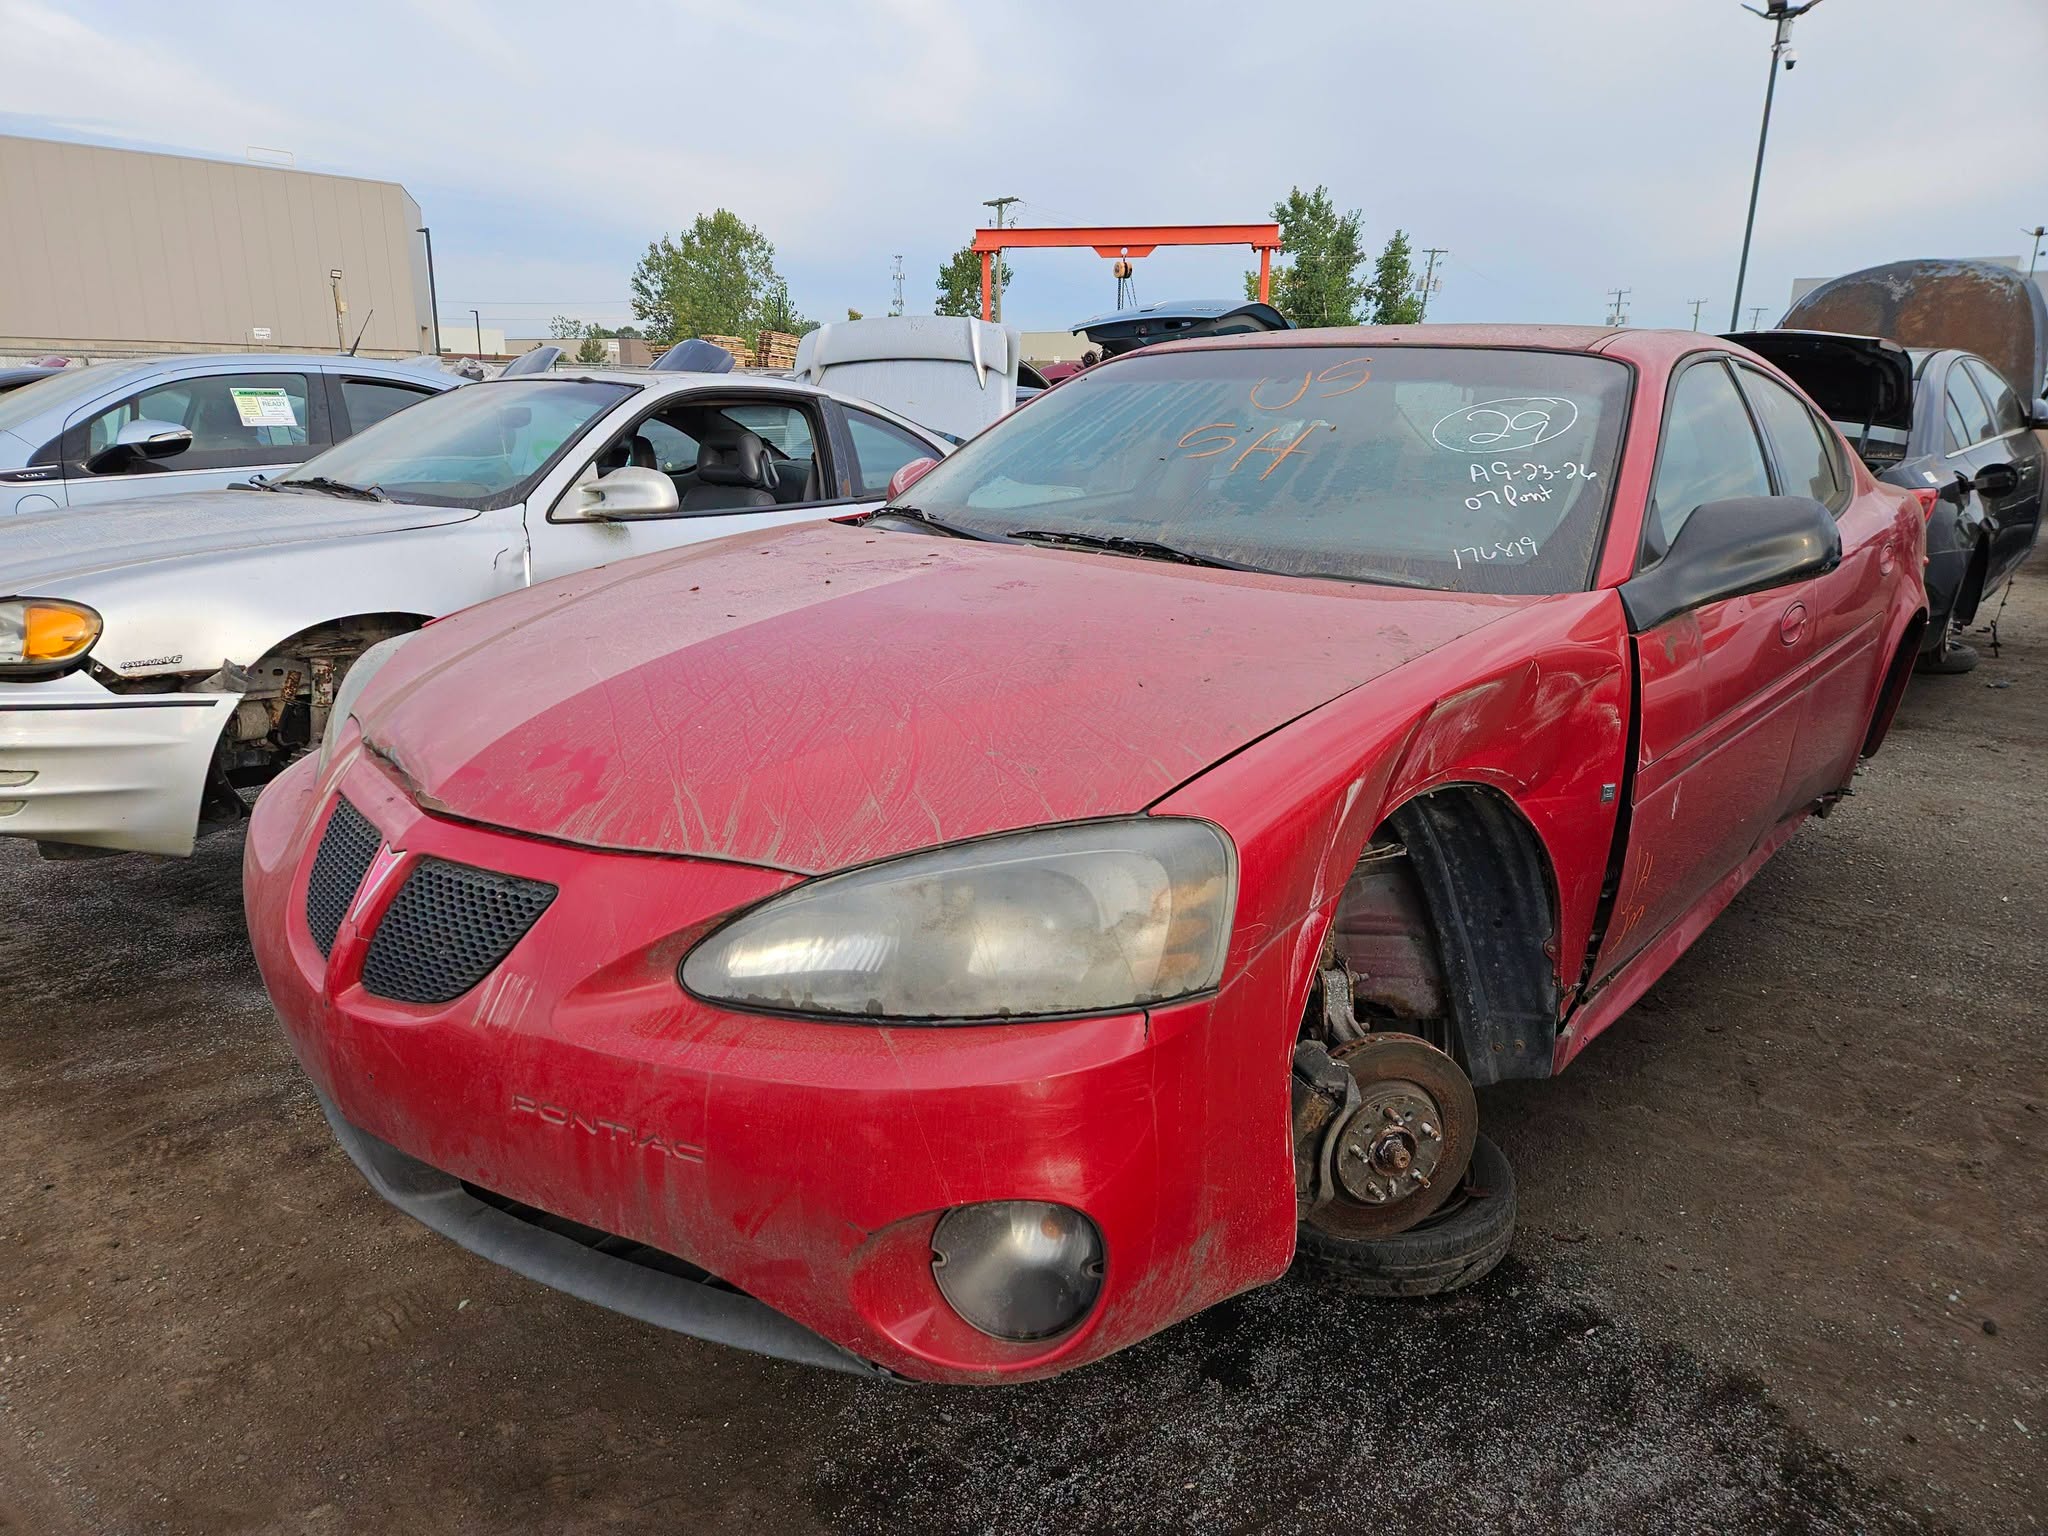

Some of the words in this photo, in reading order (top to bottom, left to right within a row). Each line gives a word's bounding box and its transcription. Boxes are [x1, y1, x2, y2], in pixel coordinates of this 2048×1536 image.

[1466, 409, 1550, 444] 29
[1453, 536, 1539, 570] 176819
[511, 1095, 705, 1164] PONTIAC
